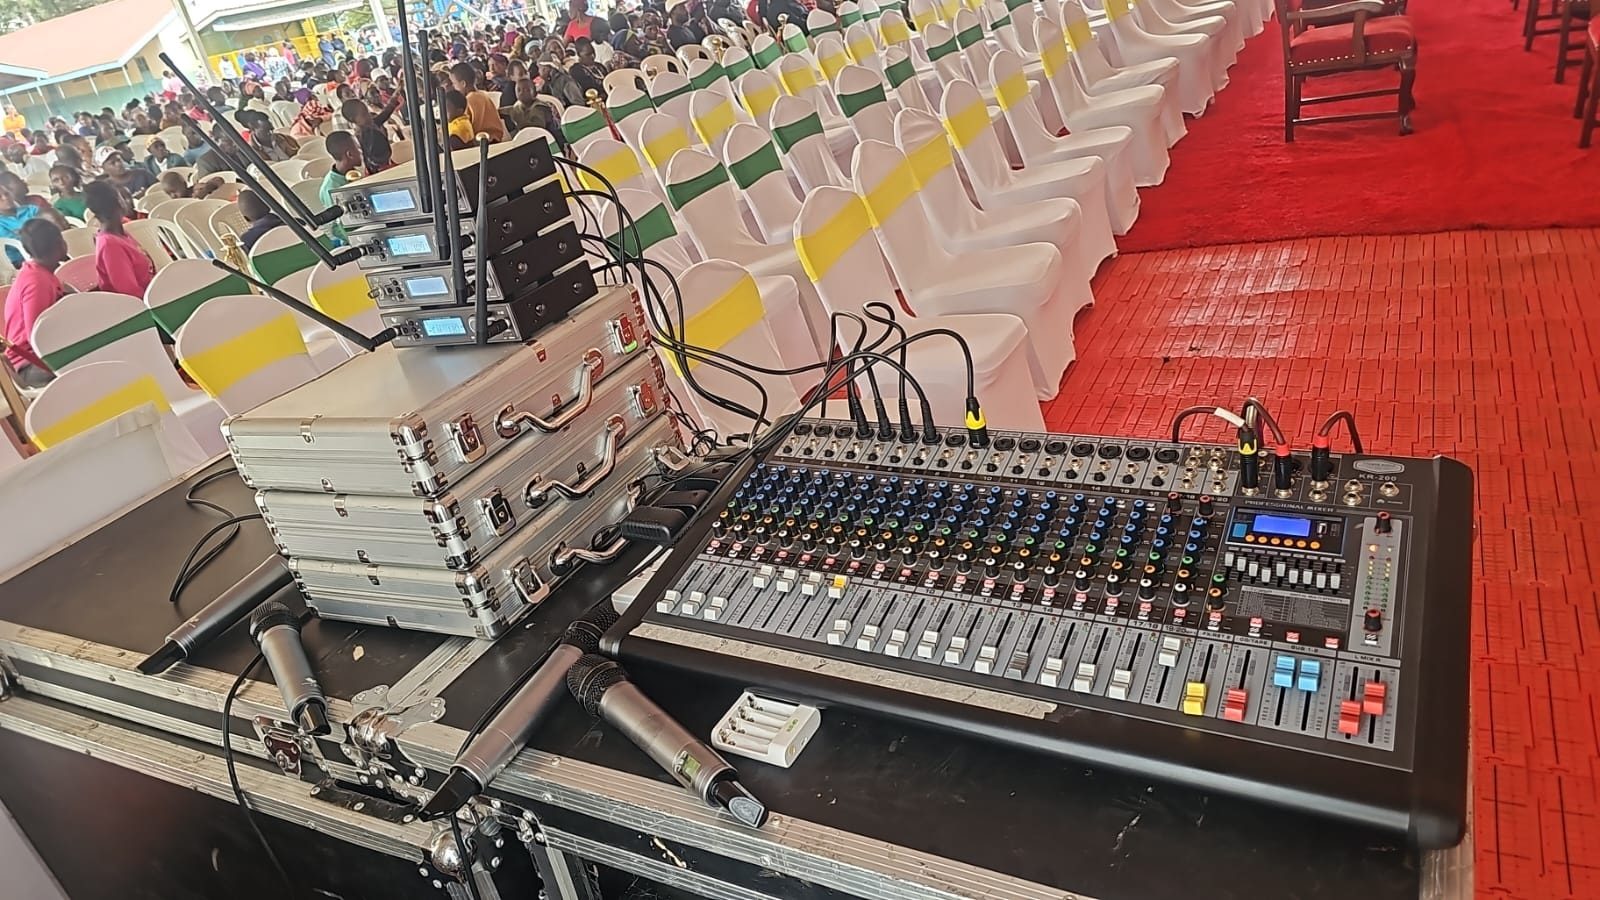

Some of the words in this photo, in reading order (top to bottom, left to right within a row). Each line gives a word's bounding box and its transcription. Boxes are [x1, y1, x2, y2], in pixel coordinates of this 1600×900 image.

[1359, 473, 1397, 482] KR-200
[1245, 499, 1304, 511] PROFESSIONAL
[1306, 505, 1334, 513] MIXER
